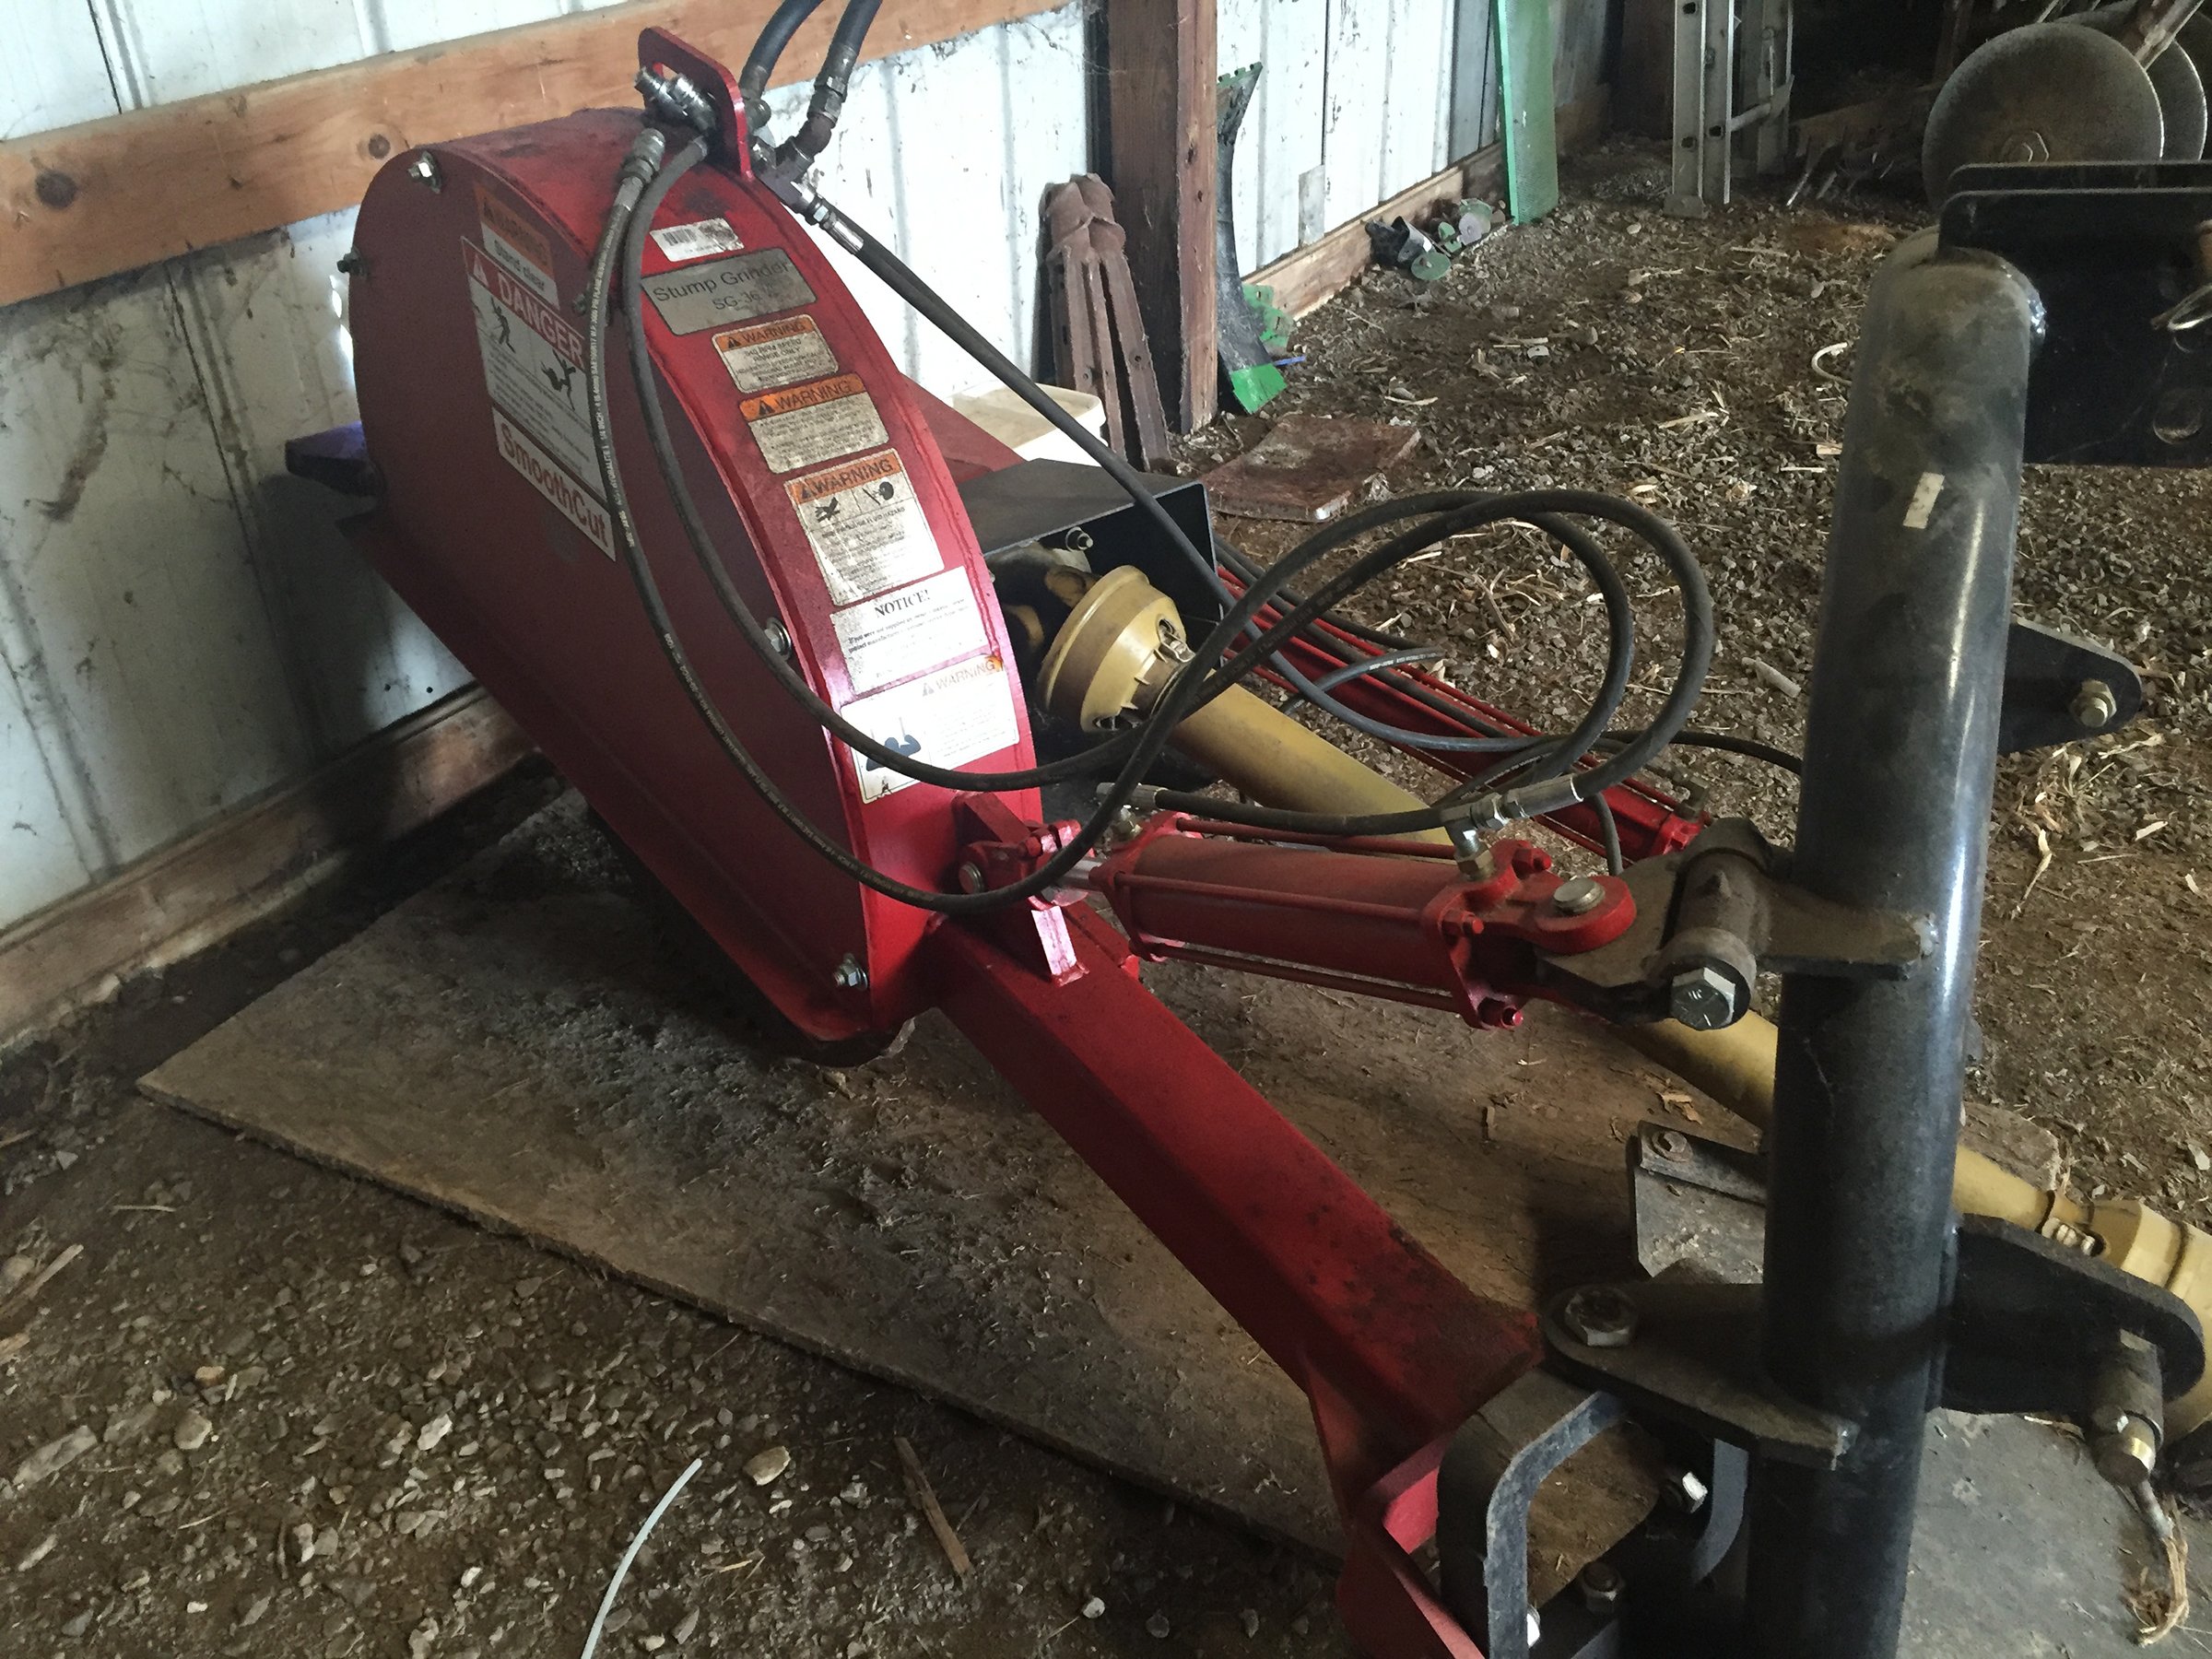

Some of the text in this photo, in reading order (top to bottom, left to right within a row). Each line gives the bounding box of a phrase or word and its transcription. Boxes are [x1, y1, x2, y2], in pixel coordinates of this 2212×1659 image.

[653, 262, 790, 302] Stump Grinder
[498, 272, 585, 370] DANGER
[741, 321, 806, 344] WARNING
[775, 380, 852, 410] WARNING
[500, 421, 609, 548] SmoothCut
[814, 459, 894, 494] WARNING
[874, 589, 931, 618] NOTICE!
[935, 659, 995, 690] WARNING
